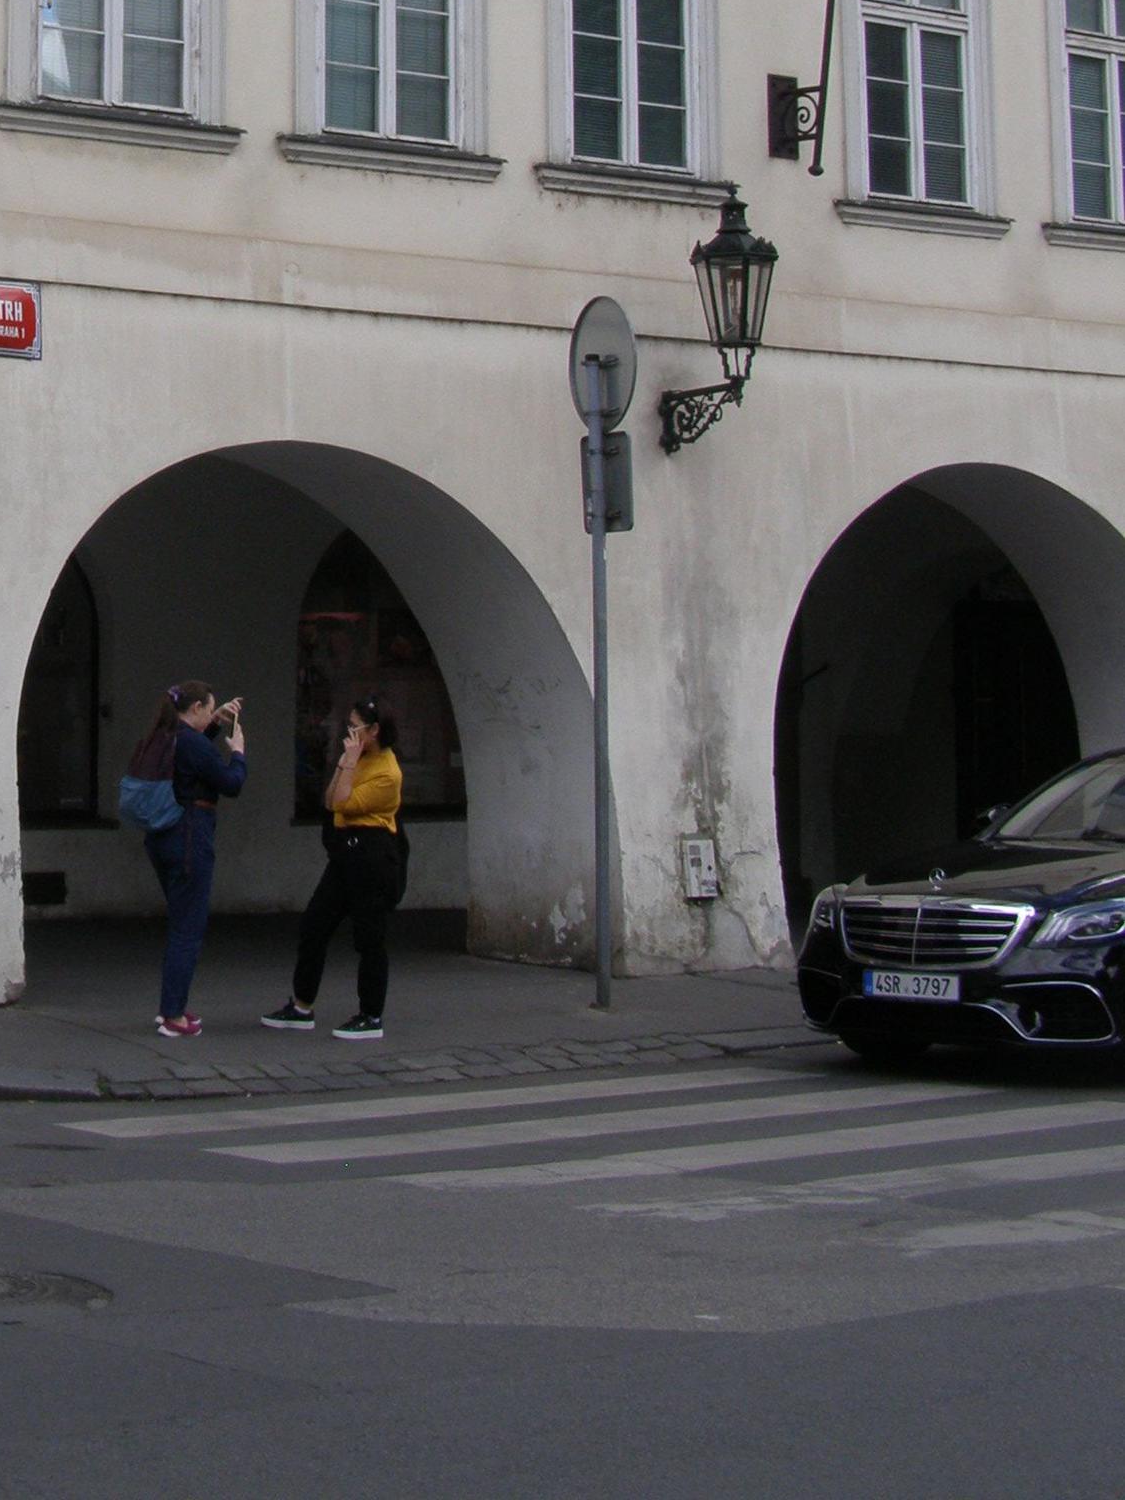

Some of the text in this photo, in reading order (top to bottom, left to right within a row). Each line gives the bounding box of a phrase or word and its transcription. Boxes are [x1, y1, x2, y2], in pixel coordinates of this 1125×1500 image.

[21, 327, 25, 339] 1
[875, 974, 950, 998] 4SR 3797
